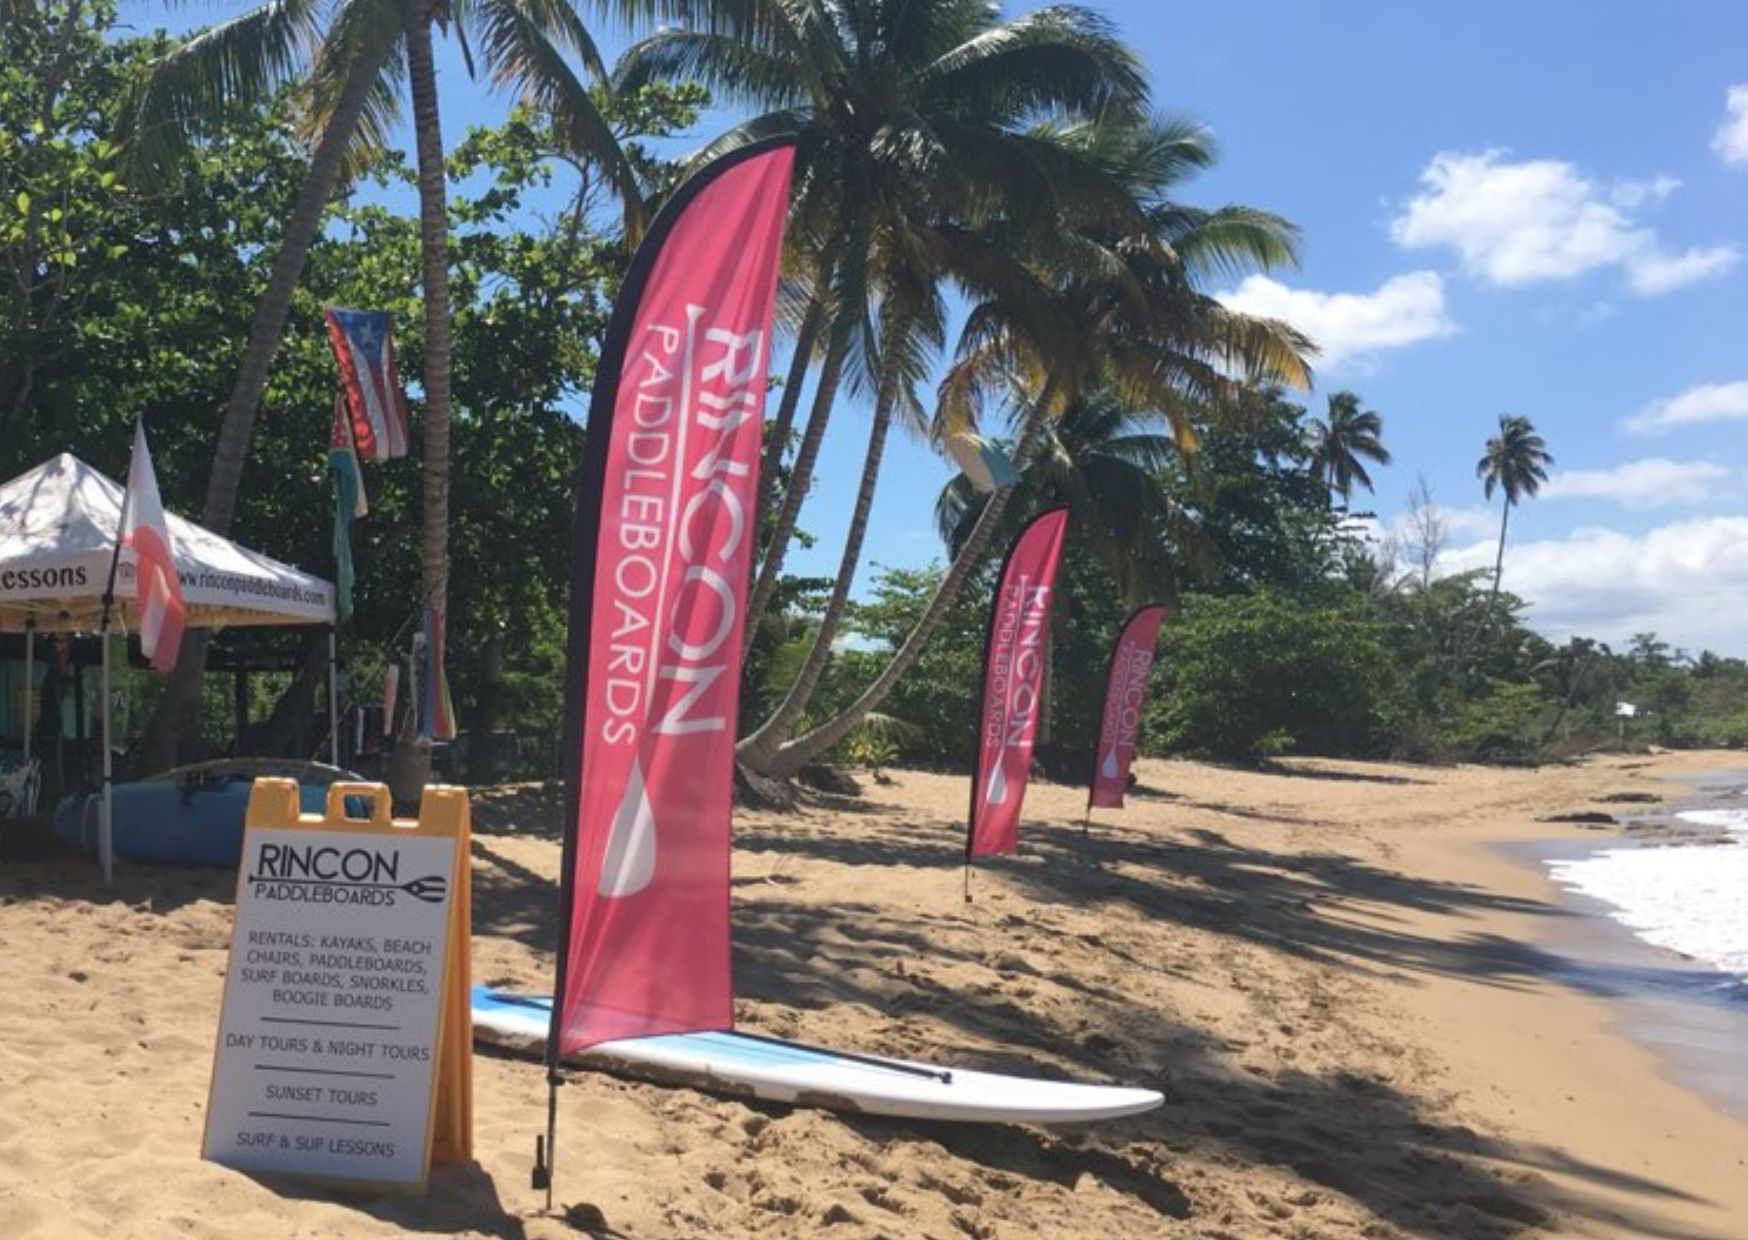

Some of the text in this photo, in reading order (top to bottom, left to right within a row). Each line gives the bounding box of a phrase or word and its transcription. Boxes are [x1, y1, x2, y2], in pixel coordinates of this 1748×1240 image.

[602, 323, 680, 745] PADDLEBOARDS
[650, 328, 764, 735] RINCON
[0, 565, 87, 590] essons
[1007, 584, 1050, 748] RINCON
[1118, 647, 1153, 747] RINCON
[257, 843, 399, 882] RINCON
[254, 883, 396, 907] PADDLEBOARDS
[249, 932, 432, 955] RENTALS: KAYAKS, BEACH
[246, 951, 427, 975] CHAIRS, PADDLEBOARDS,
[240, 969, 429, 996] SURF BOARDS, SNORKLES,
[272, 989, 393, 1011] BOOGIE BOARDS
[225, 1033, 430, 1061] DAY TOURS & NIGHT TOURS
[265, 1084, 378, 1106] SUNSET TOURS
[236, 1132, 396, 1158] SURF & SUP LESSONS
